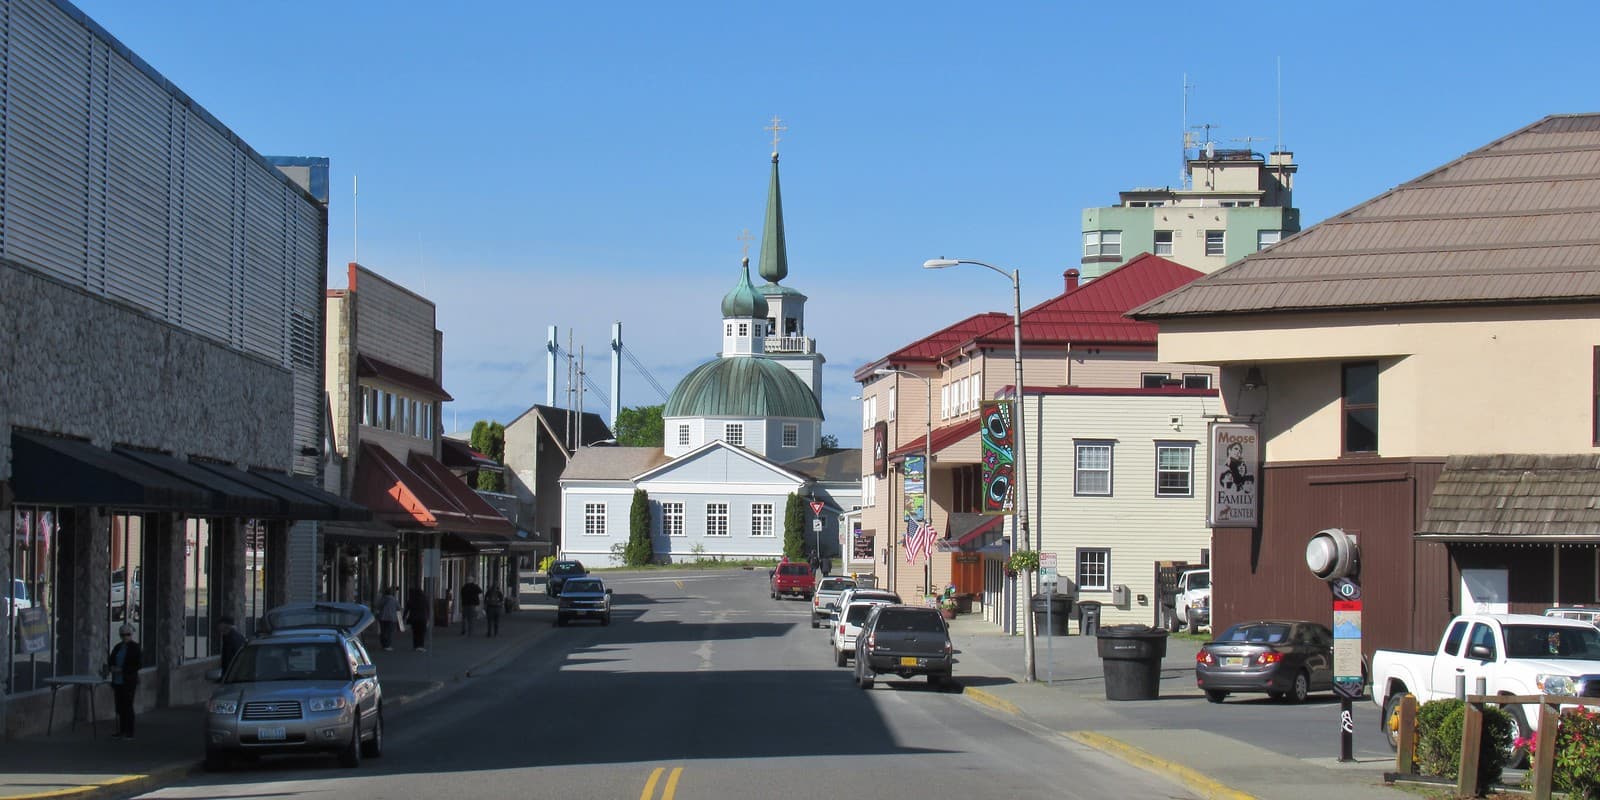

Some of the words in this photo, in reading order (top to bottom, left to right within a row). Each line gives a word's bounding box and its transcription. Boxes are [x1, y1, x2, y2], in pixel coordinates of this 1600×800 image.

[1218, 432, 1255, 444] Moose
[1217, 491, 1254, 504] FAMILY
[1229, 508, 1254, 518] CENTER
